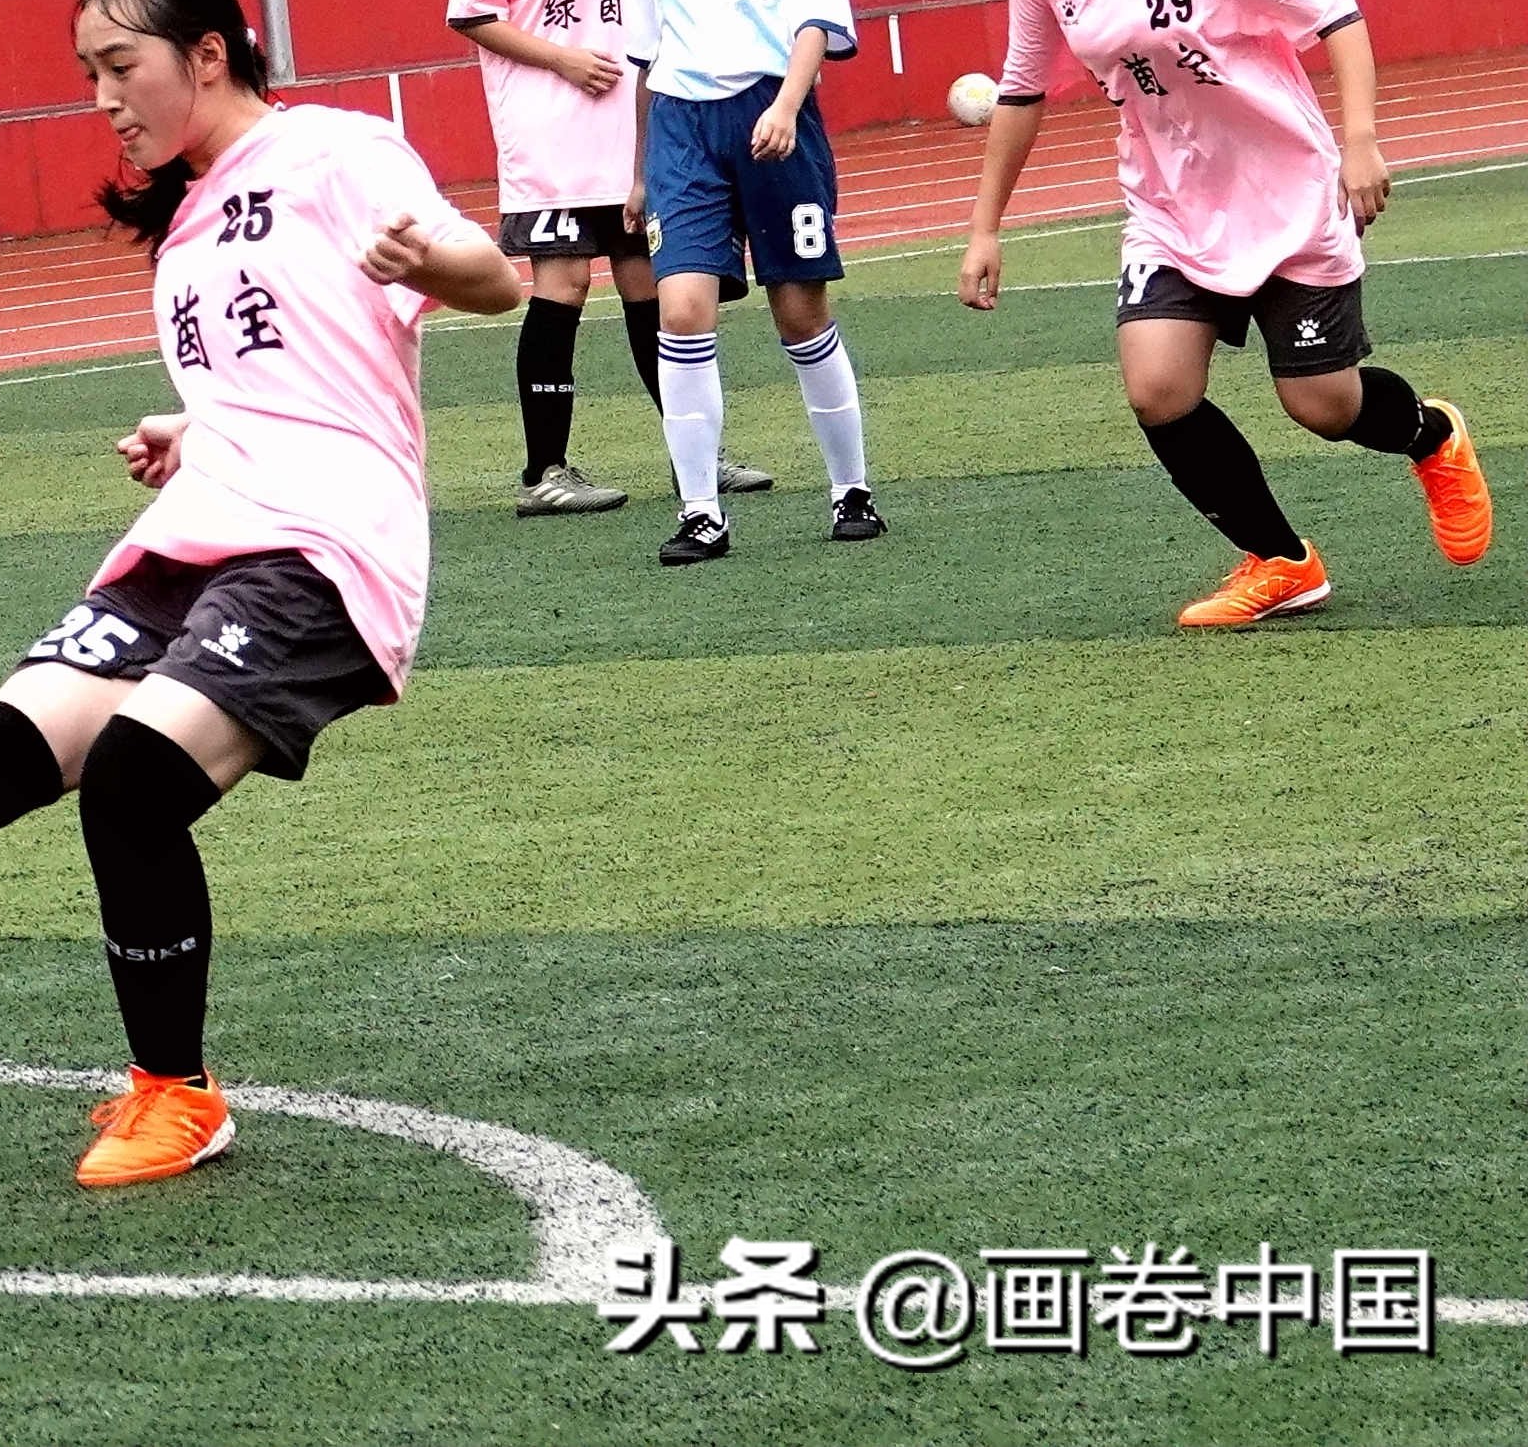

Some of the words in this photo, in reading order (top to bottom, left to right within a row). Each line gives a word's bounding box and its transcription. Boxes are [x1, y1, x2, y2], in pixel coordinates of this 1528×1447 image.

[216, 189, 274, 247] 25
[792, 204, 826, 258] 8
[29, 607, 140, 667] 25
